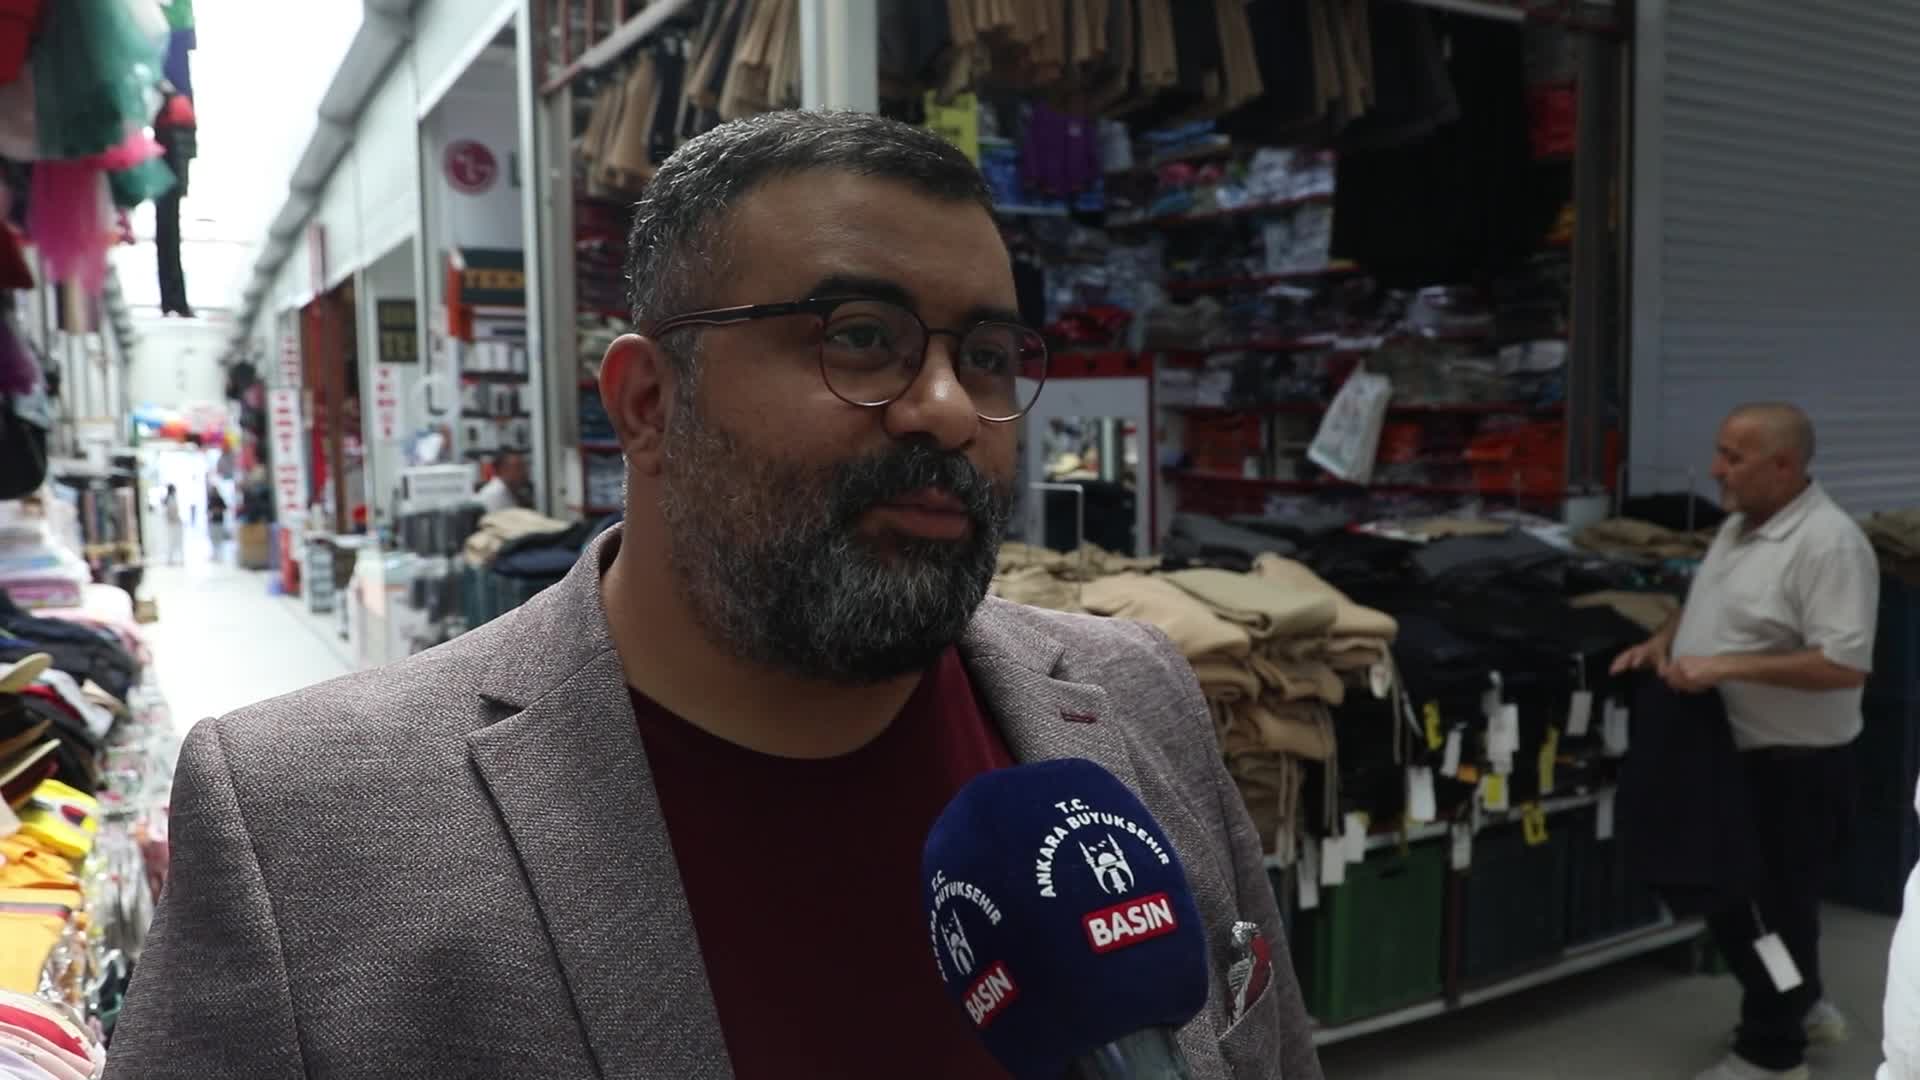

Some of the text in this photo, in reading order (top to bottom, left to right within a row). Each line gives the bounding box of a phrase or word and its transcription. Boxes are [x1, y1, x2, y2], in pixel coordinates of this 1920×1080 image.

[1055, 798, 1090, 814] T.C.
[1036, 826, 1069, 897] ANKARA
[1088, 898, 1174, 947] BASIN
[965, 967, 1014, 1025] BASIN
